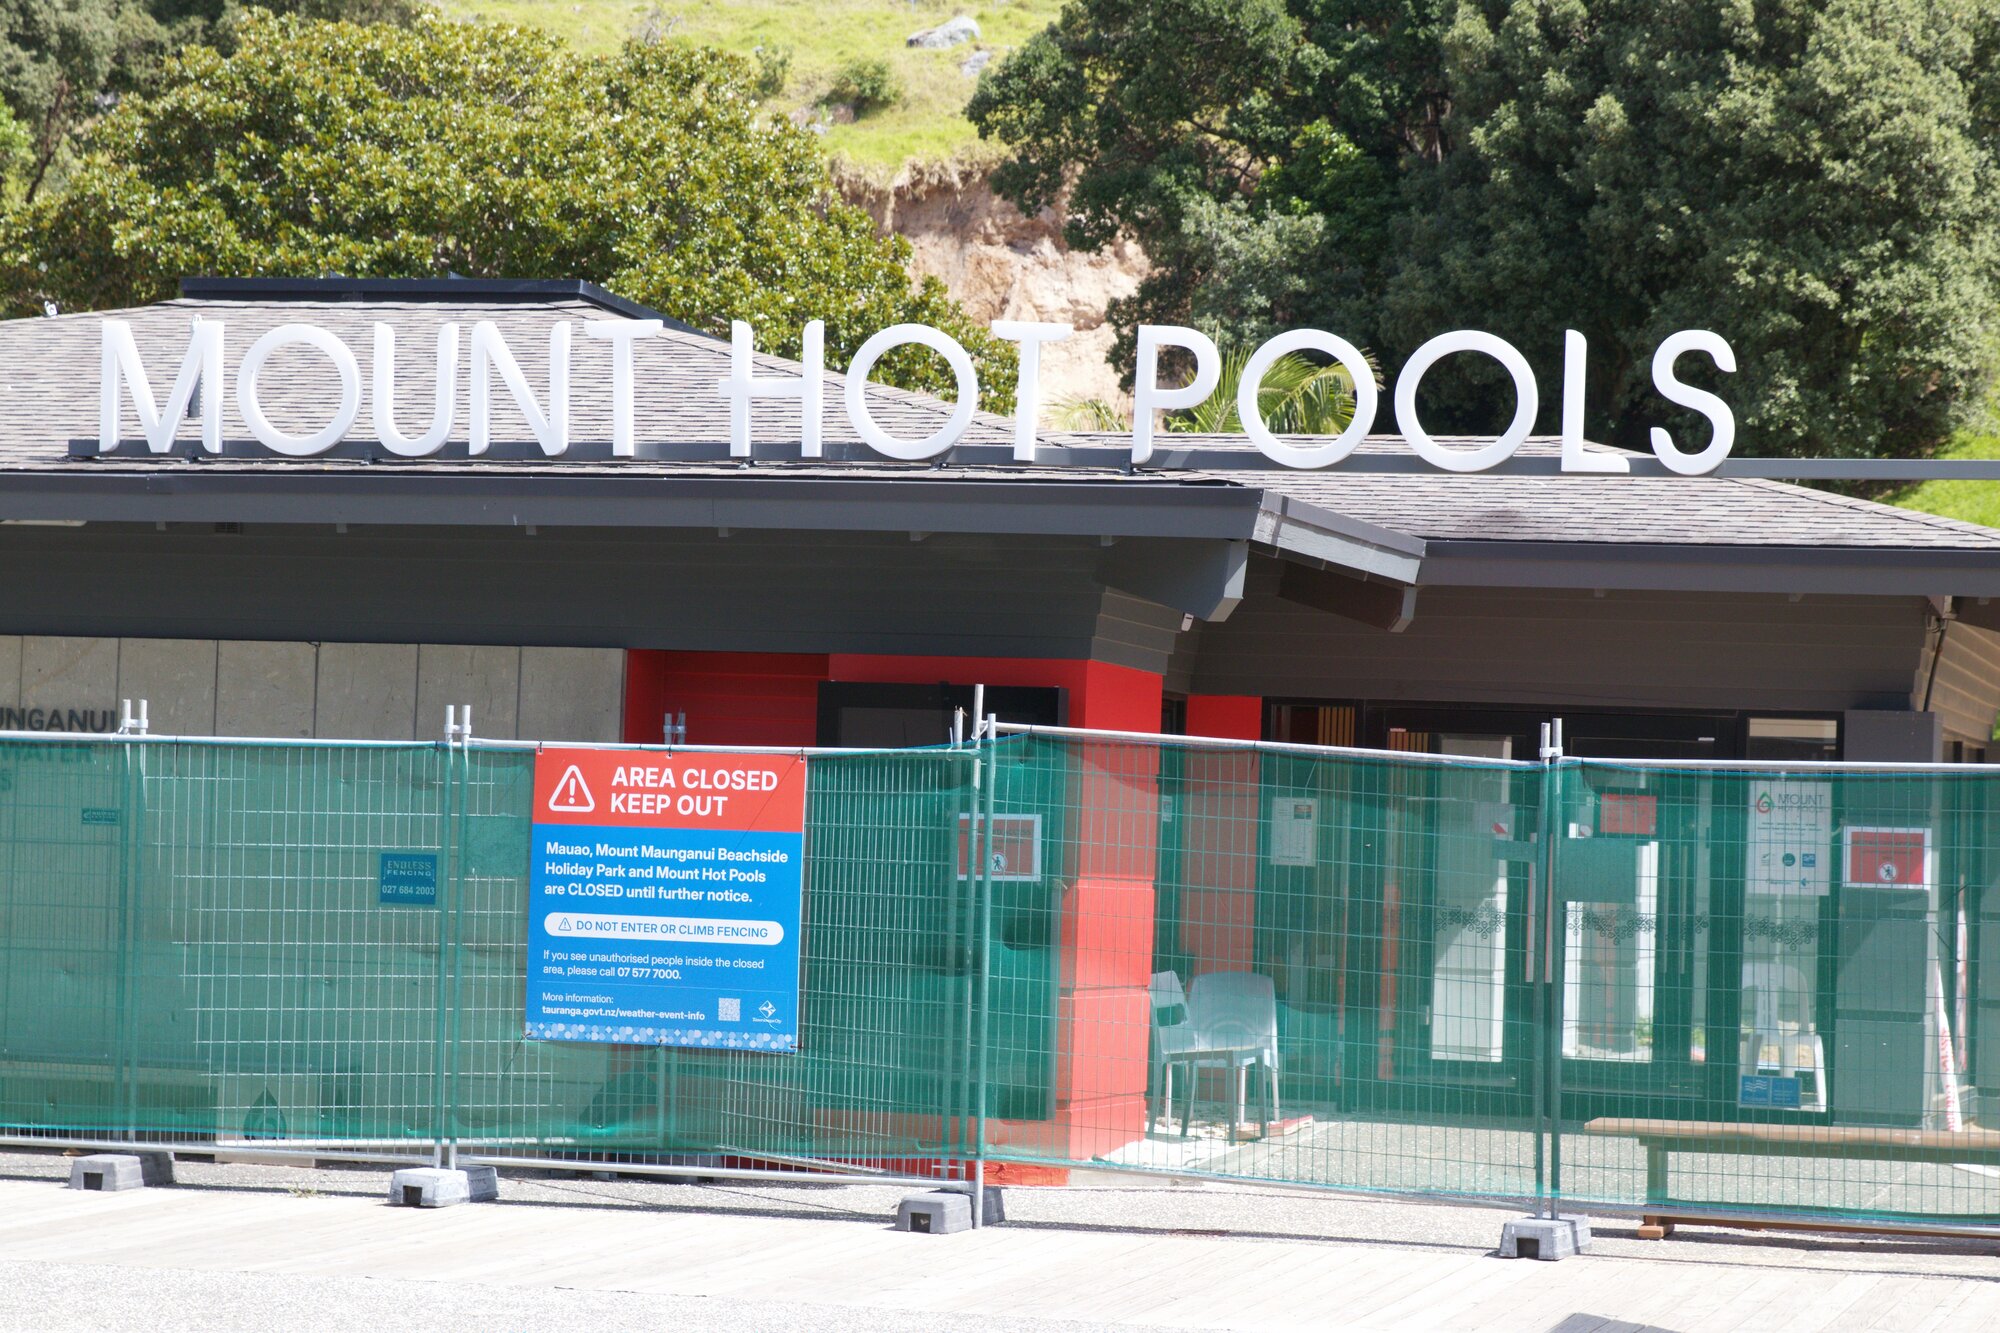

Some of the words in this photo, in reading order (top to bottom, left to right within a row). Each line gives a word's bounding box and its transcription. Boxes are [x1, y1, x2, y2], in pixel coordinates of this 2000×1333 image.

[99, 318, 663, 457] MOUNT
[718, 319, 1073, 462] HOT
[1131, 324, 1737, 476] POOLS
[611, 766, 676, 788] AREA
[682, 768, 778, 791] CLOSED
[610, 793, 671, 815] KEEP
[676, 794, 728, 817] OUT
[546, 841, 593, 858] Mauao,
[596, 843, 638, 857] Mount
[641, 845, 715, 862] Maunganui
[718, 847, 788, 863] Beachside
[386, 869, 431, 877] FENCING
[387, 860, 431, 870] ENDLESS
[545, 862, 594, 879] Holiday
[596, 863, 626, 877] Park
[628, 866, 653, 878] and
[656, 866, 699, 880] Mount
[702, 867, 726, 881] Hot
[729, 868, 766, 883] Pools
[382, 885, 397, 894] 027
[399, 885, 413, 894] 684
[415, 886, 435, 896] 2003
[544, 884, 565, 895] are
[568, 882, 623, 897] CLOSED
[626, 886, 655, 899] until
[658, 886, 704, 900] further
[707, 889, 752, 902] notice.
[576, 920, 592, 930] DO
[595, 921, 618, 931] NOT
[621, 922, 657, 933] ENTER
[660, 924, 676, 934] OR
[679, 924, 714, 936] CLIMB
[717, 926, 768, 938] FENCING
[543, 949, 550, 959] If
[551, 952, 568, 961] you
[570, 953, 587, 961] see
[589, 953, 649, 964] unauthorised
[651, 955, 683, 967] people
[685, 956, 713, 967] inside
[715, 957, 731, 967] the
[732, 958, 765, 969] closed
[543, 966, 565, 976] area,
[567, 965, 597, 976] please
[599, 967, 615, 976] call
[617, 967, 630, 977] 07
[632, 968, 651, 978] 577
[652, 968, 682, 980] 7000.
[542, 992, 563, 1002] More
[565, 992, 614, 1004] information:
[542, 1005, 705, 1021] tauranga.govt.nz/weather-event-info
